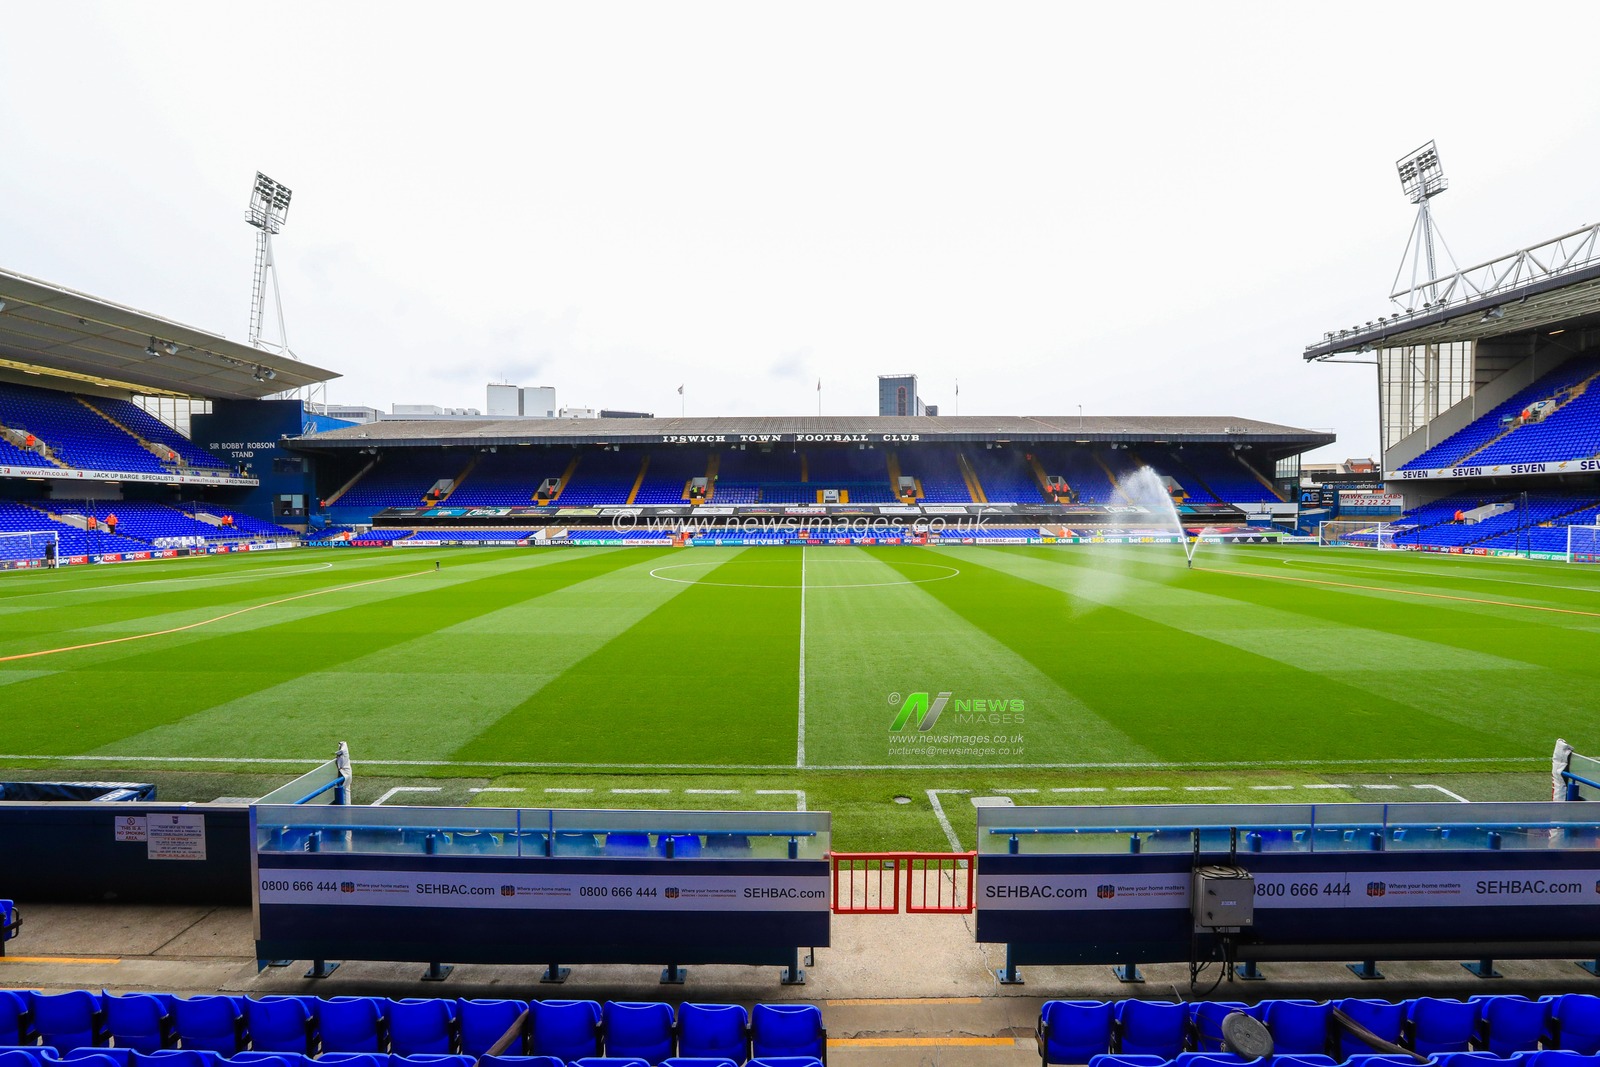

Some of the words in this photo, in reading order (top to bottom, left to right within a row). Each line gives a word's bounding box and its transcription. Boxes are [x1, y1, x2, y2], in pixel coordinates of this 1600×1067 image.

[740, 434, 782, 442] TOWN
[796, 434, 869, 442] FOOTBALL
[883, 434, 920, 442] CLUB
[209, 442, 220, 450] SIR
[221, 442, 244, 450] BOBBY
[1452, 467, 1482, 477] SEVEN
[1510, 463, 1546, 474] SEVEN
[1402, 470, 1428, 479] SEVEN
[154, 550, 164, 558] sky
[1440, 546, 1450, 554] sky
[1464, 547, 1474, 555] sky
[125, 552, 135, 561] sky
[261, 880, 290, 892] 0800
[292, 880, 314, 892] 666
[316, 881, 338, 892] 444
[416, 883, 495, 896] SEHBAC.com
[985, 884, 1088, 898] SEHBAC.com
[1253, 883, 1285, 897] 800
[1289, 882, 1318, 897] 666
[1322, 881, 1351, 896] 444
[1475, 879, 1582, 894] SEHBAC.com
[579, 886, 609, 898] 0800
[611, 886, 633, 898] 666
[635, 886, 657, 898] 444
[743, 887, 825, 899] SEHBAC.com
